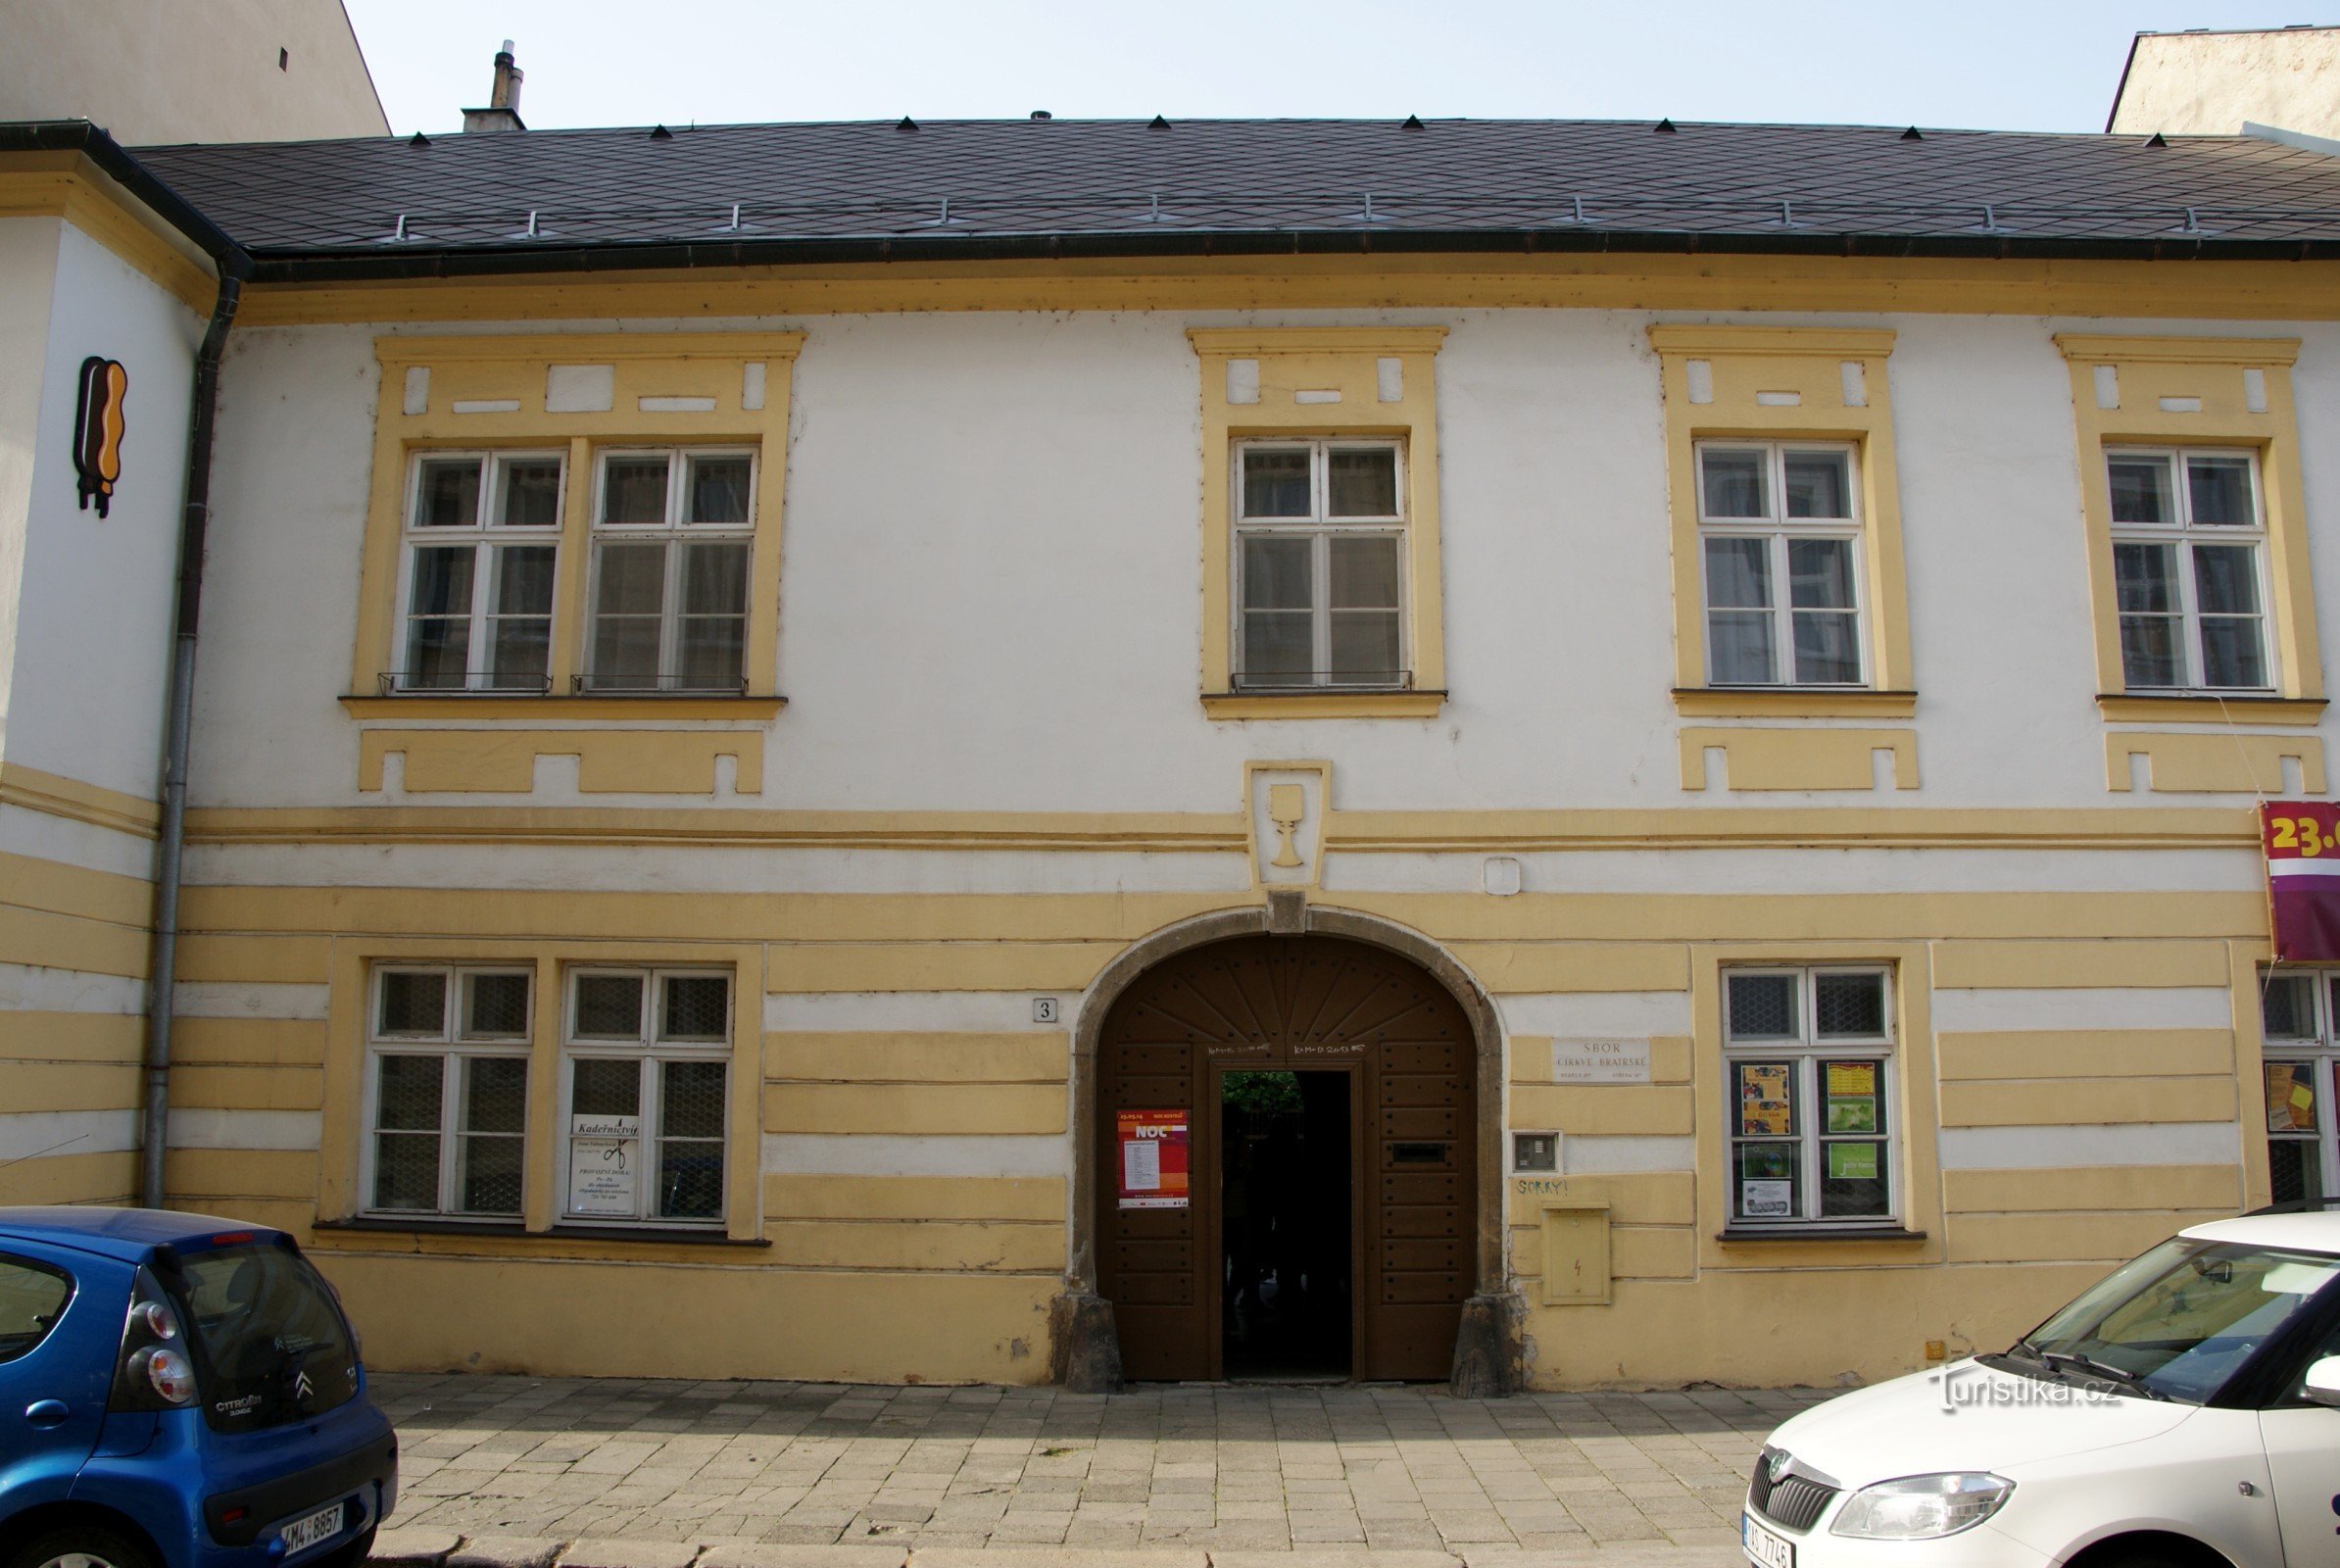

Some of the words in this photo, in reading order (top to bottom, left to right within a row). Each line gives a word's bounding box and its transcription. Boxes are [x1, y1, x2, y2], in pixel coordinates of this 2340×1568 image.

[2271, 817, 2340, 857] 23.
[1041, 1002, 1049, 1018] 3
[1584, 1043, 1621, 1053] SBOR
[1557, 1055, 1592, 1066] CÍRKVE
[1599, 1055, 1646, 1066] BRATRSKÉ
[578, 1123, 635, 1134] Kadeřnictví
[1136, 1125, 1167, 1138] NOC
[314, 1507, 339, 1540] 8857
[1764, 1535, 1787, 1568] 7746
